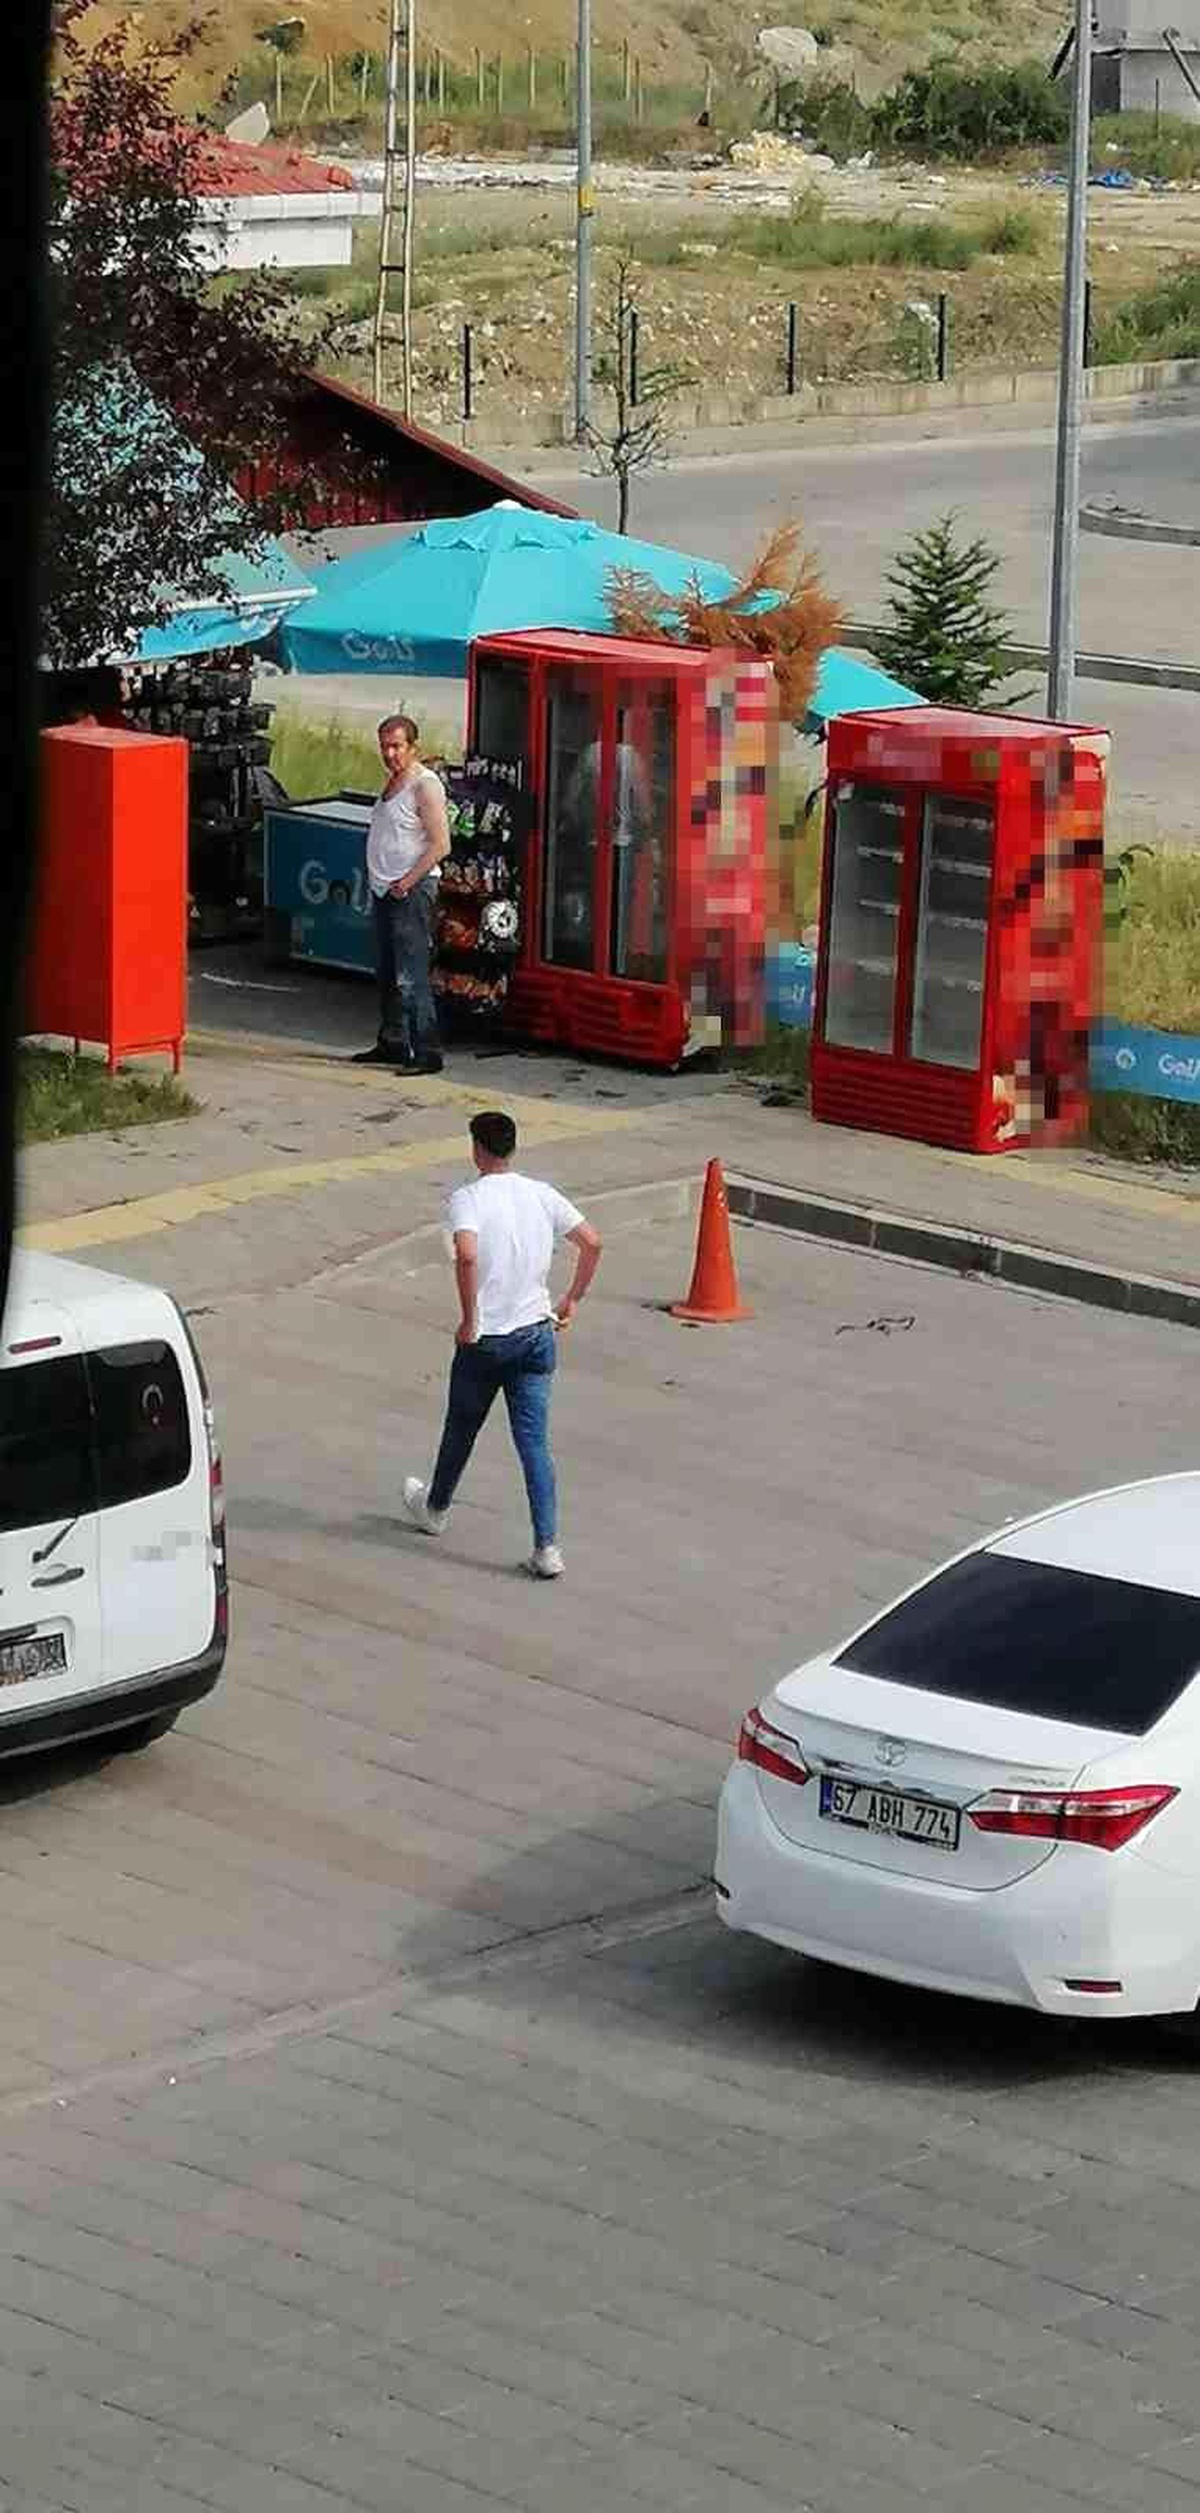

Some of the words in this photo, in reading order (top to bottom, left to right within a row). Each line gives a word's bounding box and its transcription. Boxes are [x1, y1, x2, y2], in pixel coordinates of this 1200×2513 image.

[299, 860, 372, 917] Gol
[867, 1794, 904, 1828] ABH
[913, 1805, 950, 1839] 774
